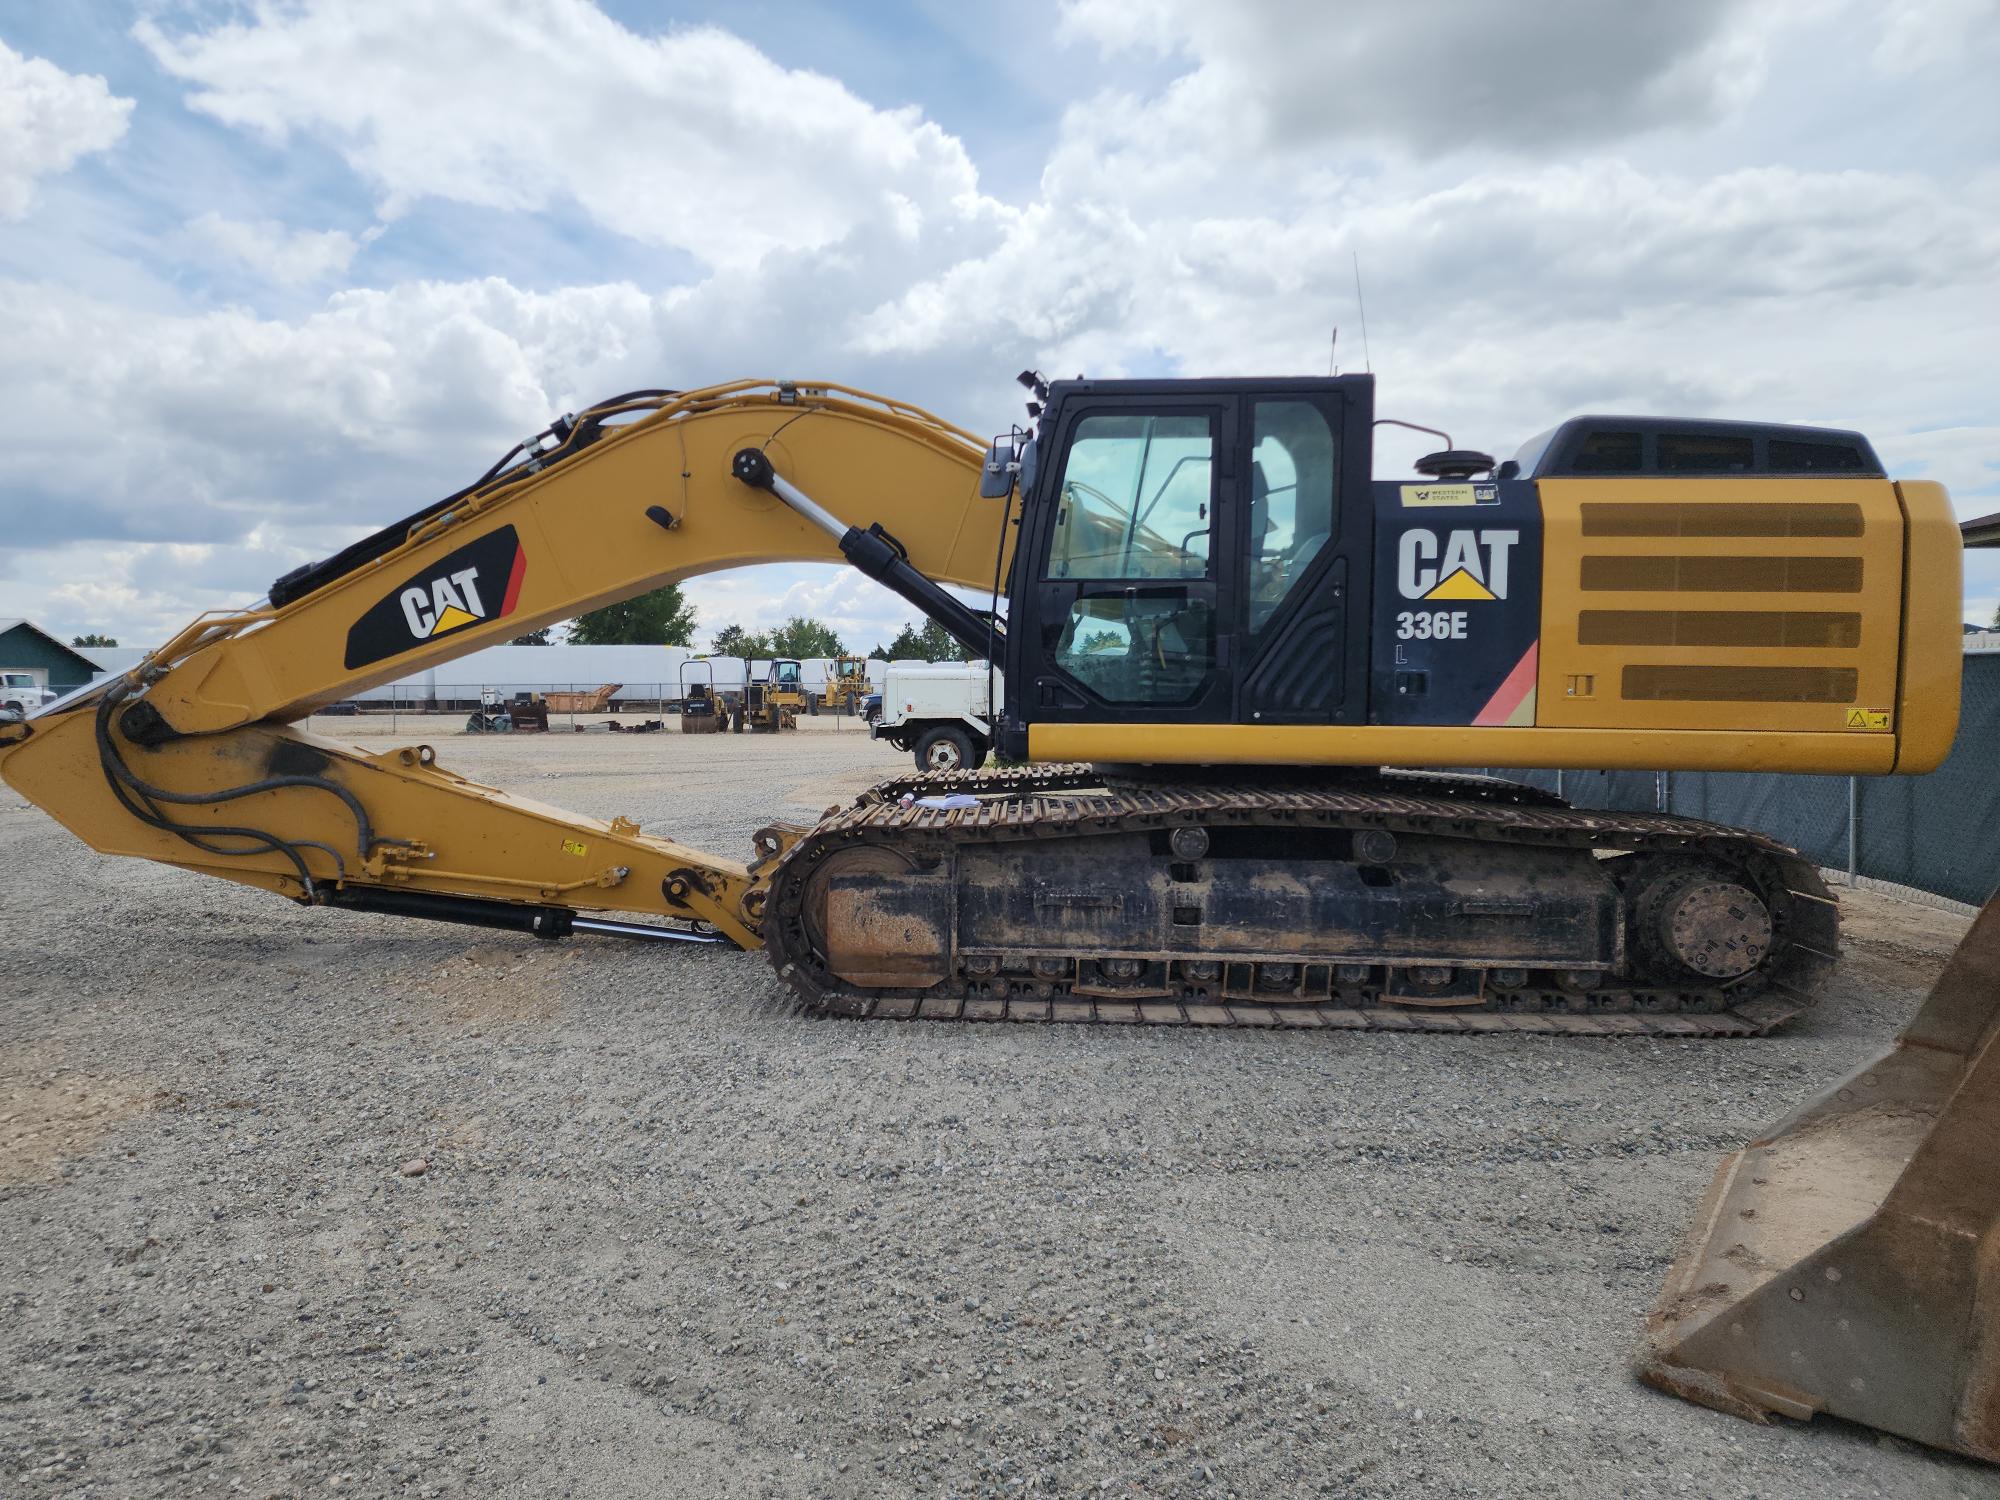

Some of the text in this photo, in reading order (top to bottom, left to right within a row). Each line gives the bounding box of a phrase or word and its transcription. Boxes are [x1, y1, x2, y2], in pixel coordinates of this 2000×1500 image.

[1475, 489, 1496, 500] CAT
[1398, 529, 1519, 600] CAT
[400, 567, 486, 639] CAT
[1396, 611, 1468, 640] 336E
[1396, 644, 1408, 664] L
